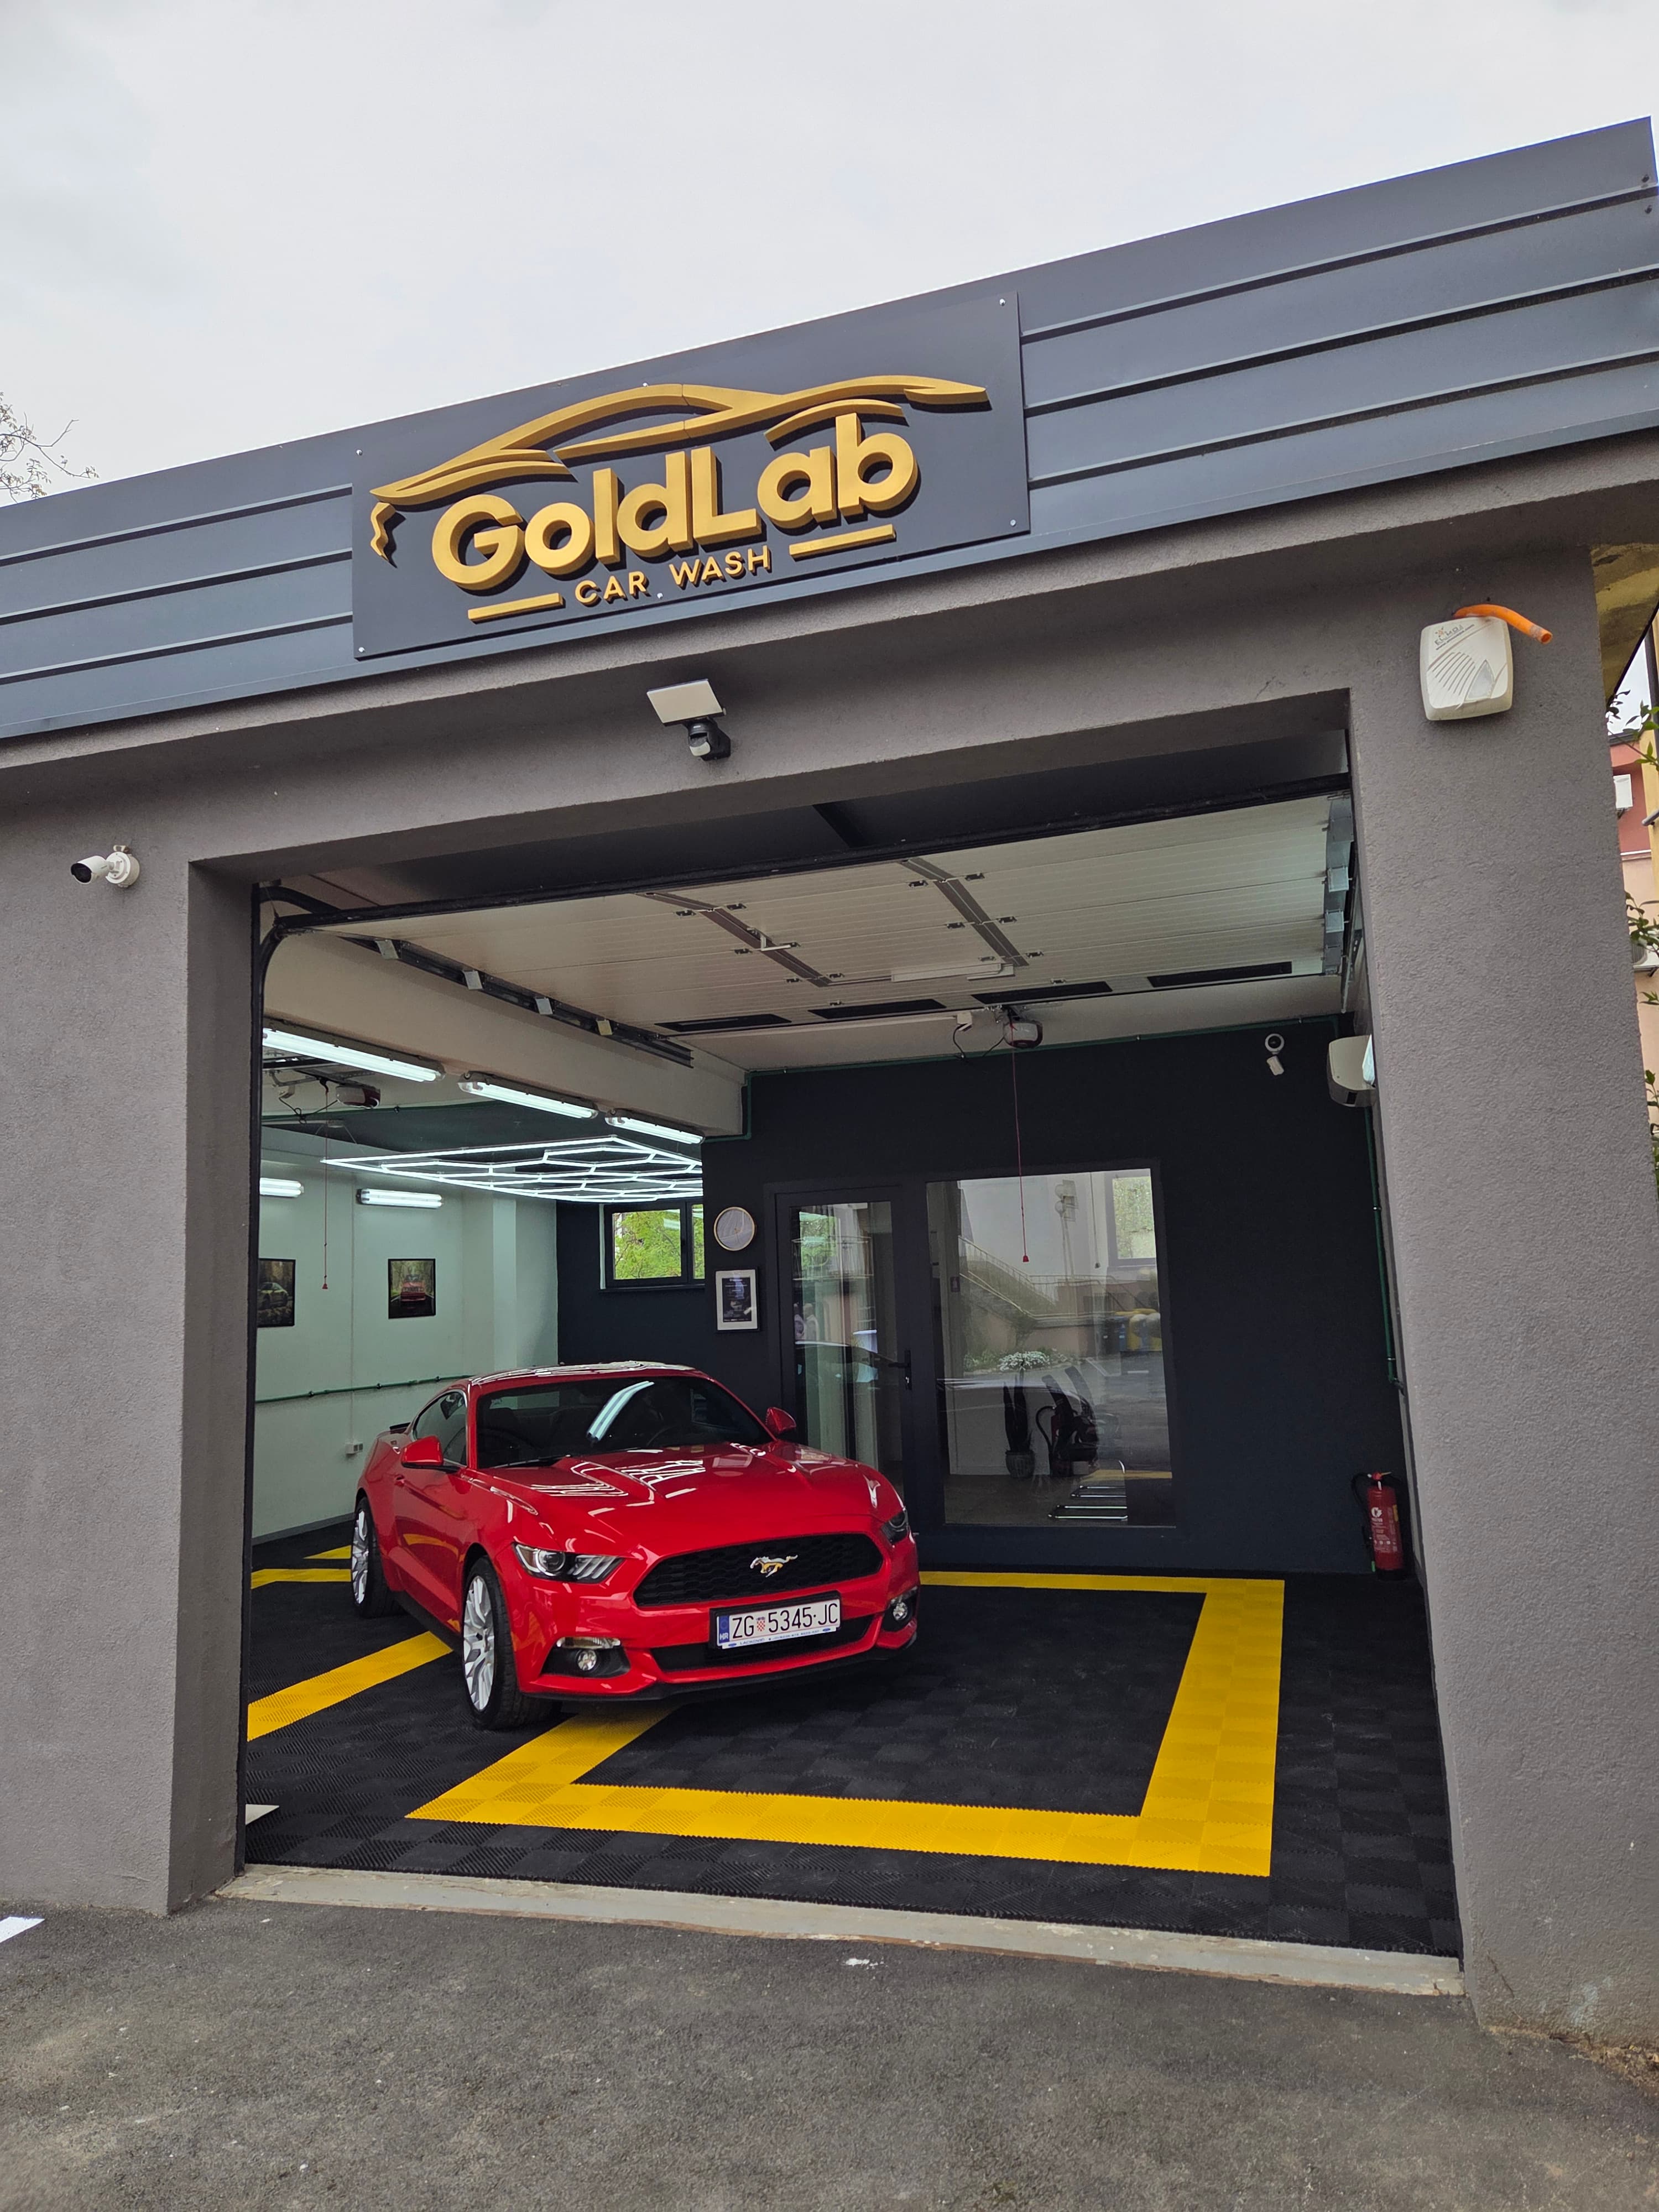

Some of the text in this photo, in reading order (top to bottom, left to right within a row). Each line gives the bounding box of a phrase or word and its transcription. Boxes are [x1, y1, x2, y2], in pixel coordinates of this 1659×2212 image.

[432, 413, 918, 590] GoldLab
[575, 545, 771, 606] CAR WASH
[719, 1632, 729, 1640] HR
[732, 1615, 754, 1639] ZG
